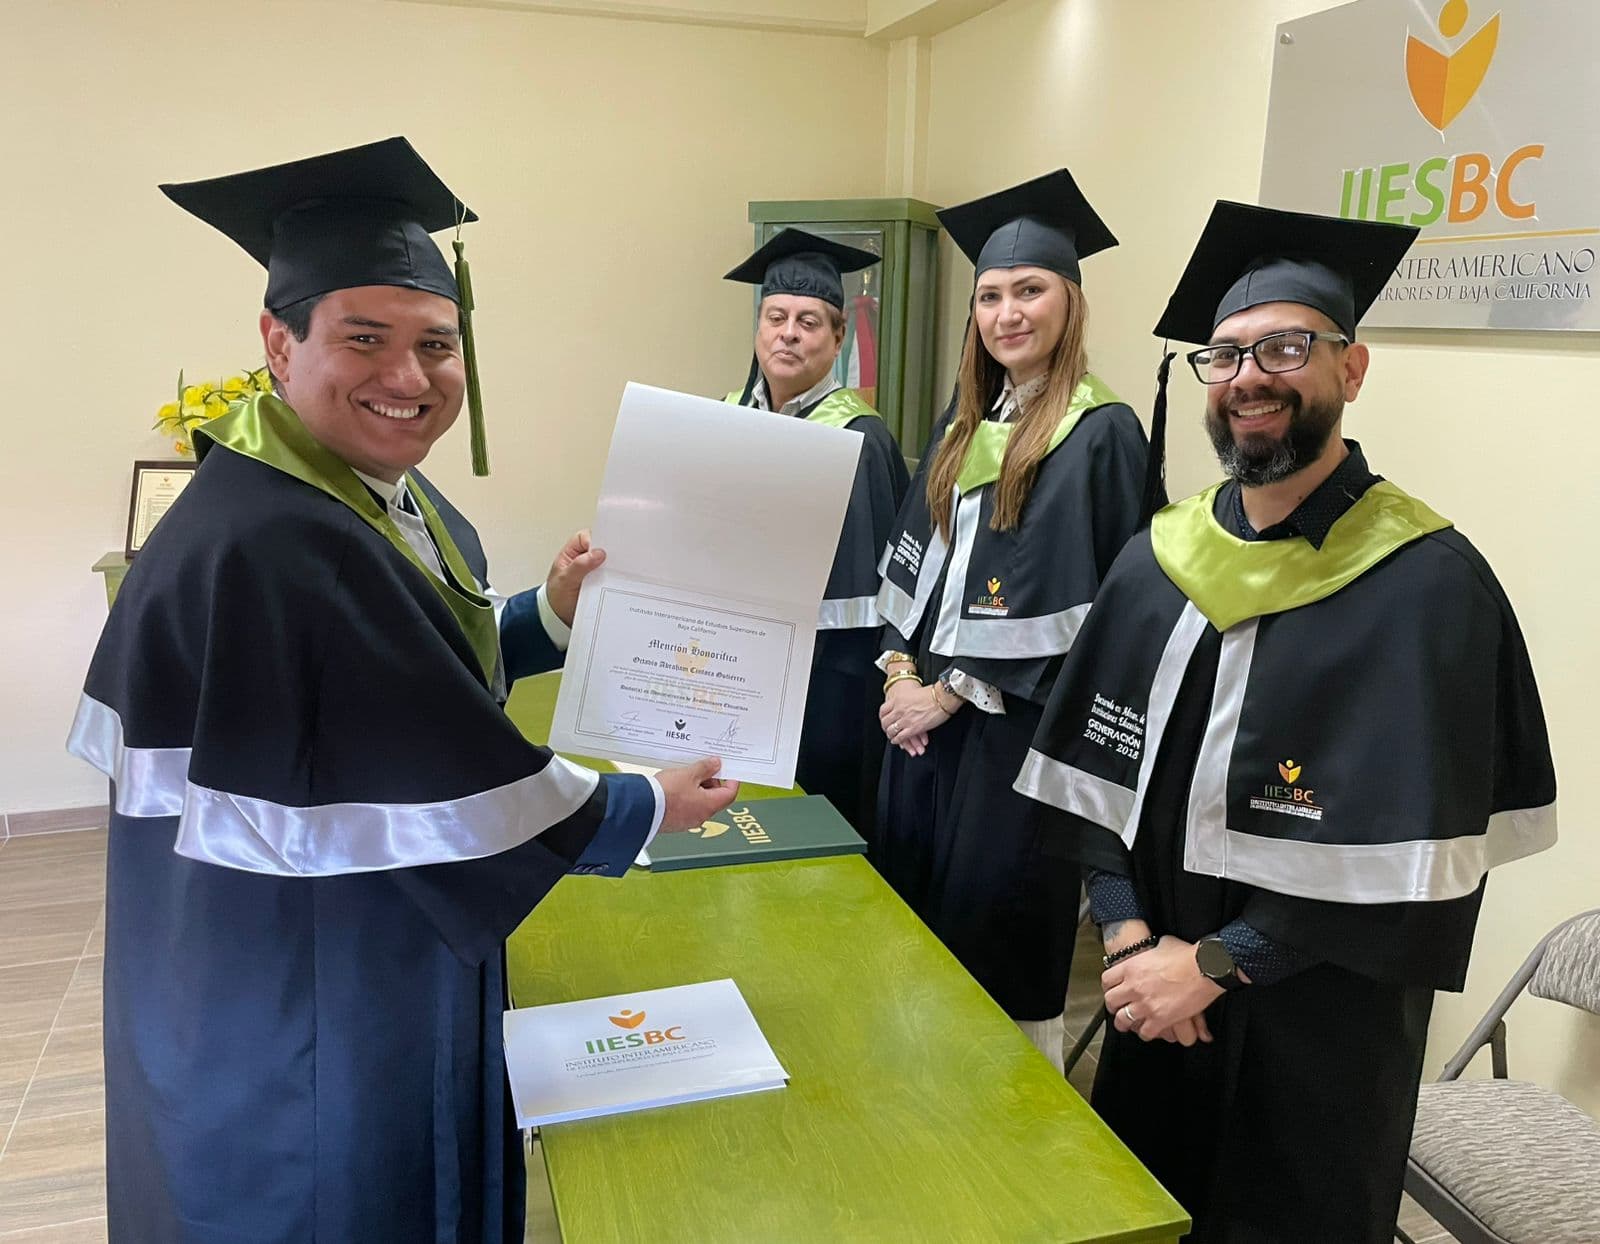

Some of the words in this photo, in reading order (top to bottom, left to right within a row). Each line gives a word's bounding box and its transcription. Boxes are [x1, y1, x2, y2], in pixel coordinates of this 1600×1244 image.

[1340, 144, 1545, 227] IIESBC
[1394, 248, 1596, 280] NTERAMERICANO
[1436, 285, 1457, 300] DE
[1459, 284, 1490, 303] BAJA
[1494, 282, 1592, 300] CALIFORNIA
[977, 595, 1005, 607] IIESBC
[654, 611, 697, 624] Interamericano
[705, 620, 728, 630] Estudios
[729, 624, 758, 636] Superiores
[678, 623, 690, 632] Baja
[690, 625, 717, 636] California
[665, 730, 692, 741] IIESBC
[1083, 728, 1107, 746] 2016
[1115, 743, 1140, 760] 2018
[1088, 718, 1141, 749] GENERACIÓN
[1264, 784, 1314, 804] IIESBC
[726, 807, 773, 844] IIESBC
[585, 1026, 686, 1054] IIESBC
